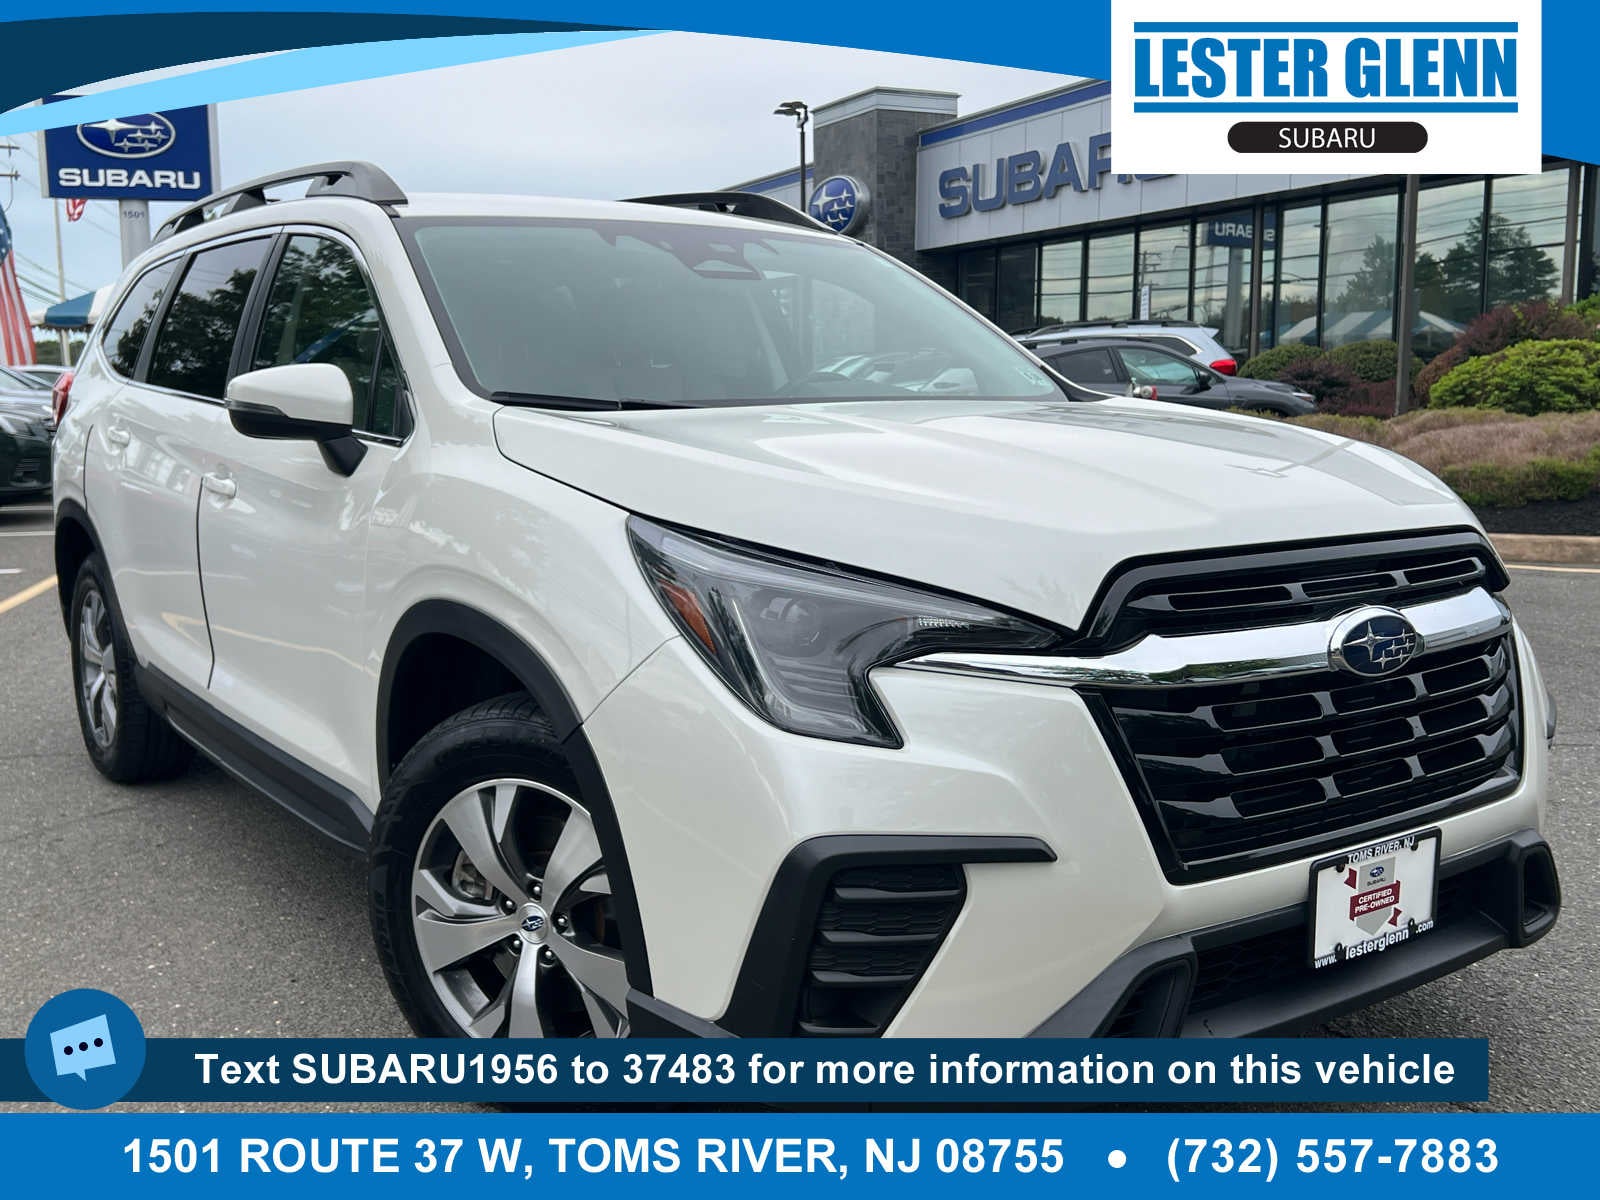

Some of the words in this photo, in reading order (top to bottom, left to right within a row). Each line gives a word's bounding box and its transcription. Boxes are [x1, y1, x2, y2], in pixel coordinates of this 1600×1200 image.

[58, 167, 201, 190] SUBARU
[123, 210, 145, 219] 1501
[1348, 848, 1373, 864] TOMS
[1403, 836, 1415, 848] NJ
[1354, 895, 1395, 914] PRE-OWNED
[1358, 888, 1393, 904] CERTIFIED
